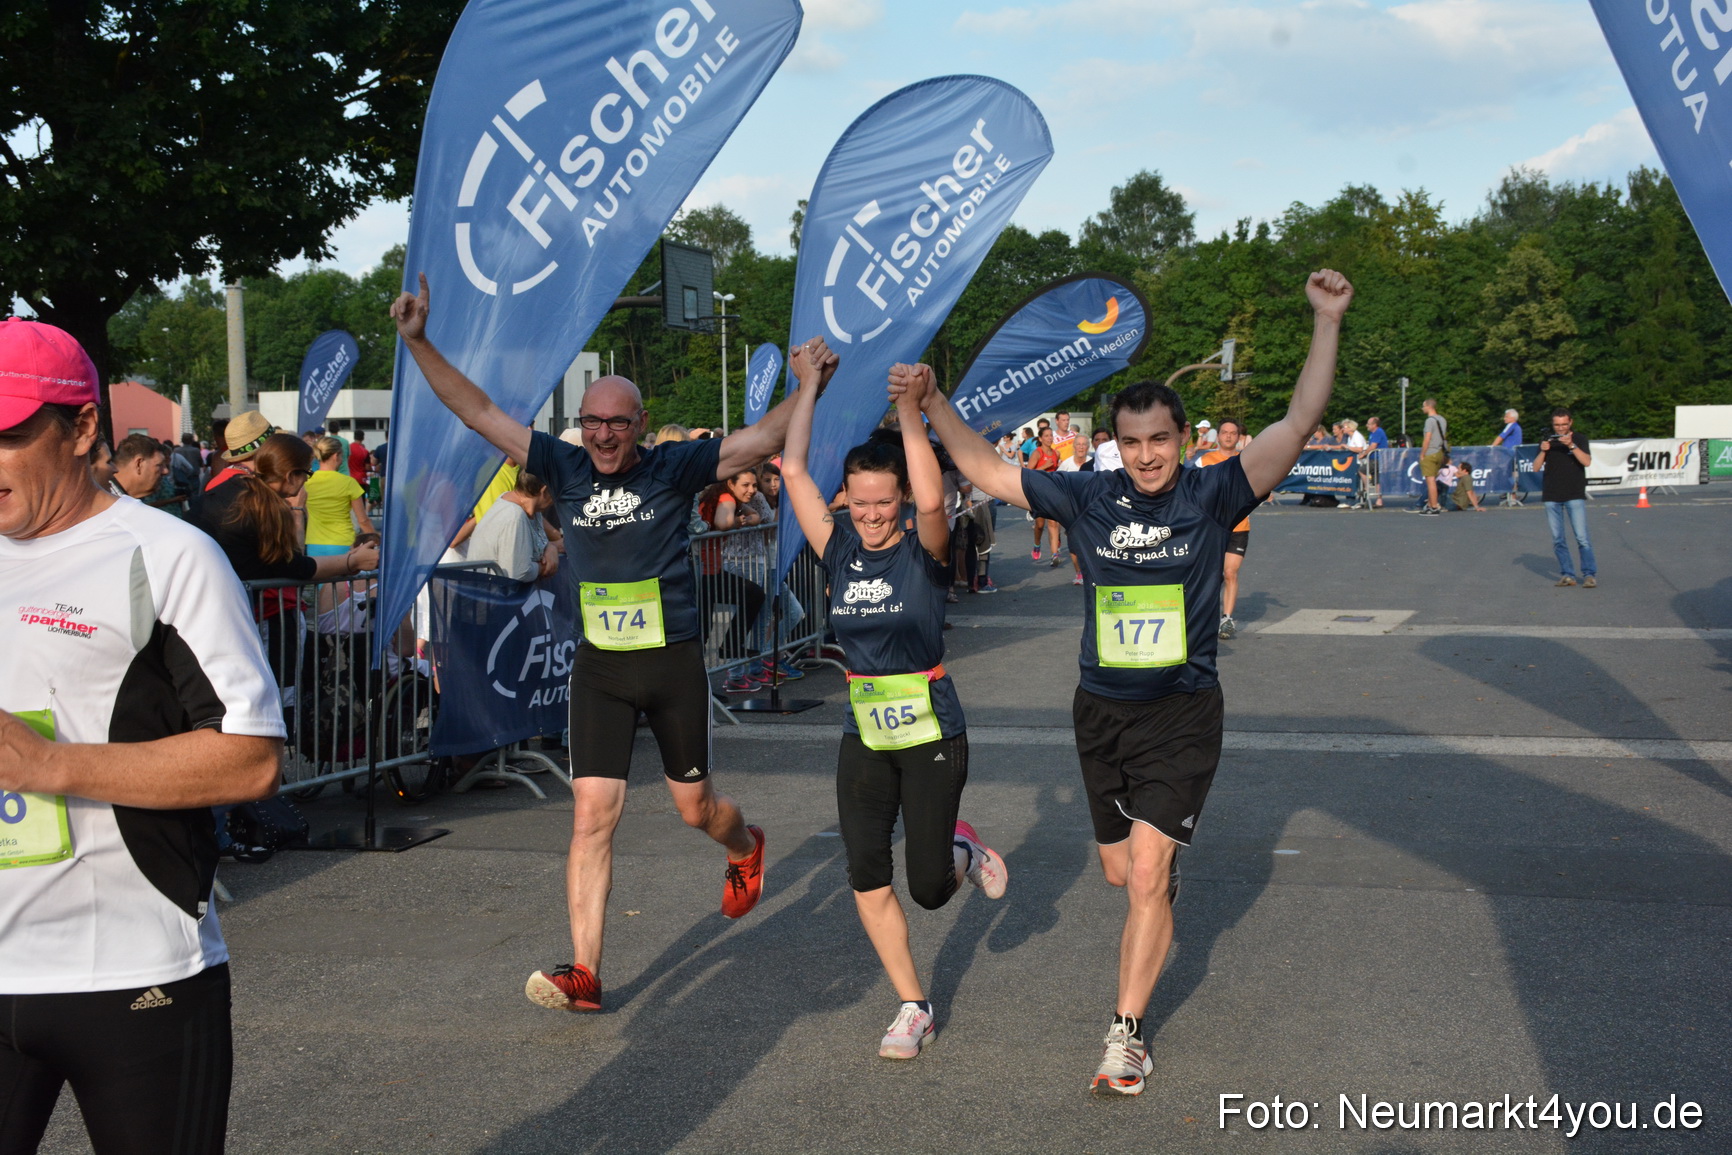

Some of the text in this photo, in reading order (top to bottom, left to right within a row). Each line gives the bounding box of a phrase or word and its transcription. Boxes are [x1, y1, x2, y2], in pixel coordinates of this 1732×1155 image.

[581, 25, 741, 248] AUTOMOBILE
[856, 117, 995, 311] Fischer
[906, 152, 1012, 307] AUTOMOBILE
[1043, 327, 1139, 385] Druck und Medien
[311, 344, 346, 404] Fischer
[956, 335, 1092, 421] Frischmann
[1626, 451, 1671, 472] swn
[1096, 543, 1189, 564] Weil's guad is!
[55, 602, 84, 615] TEAM
[598, 608, 646, 632] 174
[860, 603, 886, 617] guad
[890, 601, 903, 613] is!
[48, 626, 92, 639] LICHTWERBUNG
[1114, 619, 1165, 645] 177
[869, 705, 917, 730] 165
[130, 996, 173, 1011] adidas
